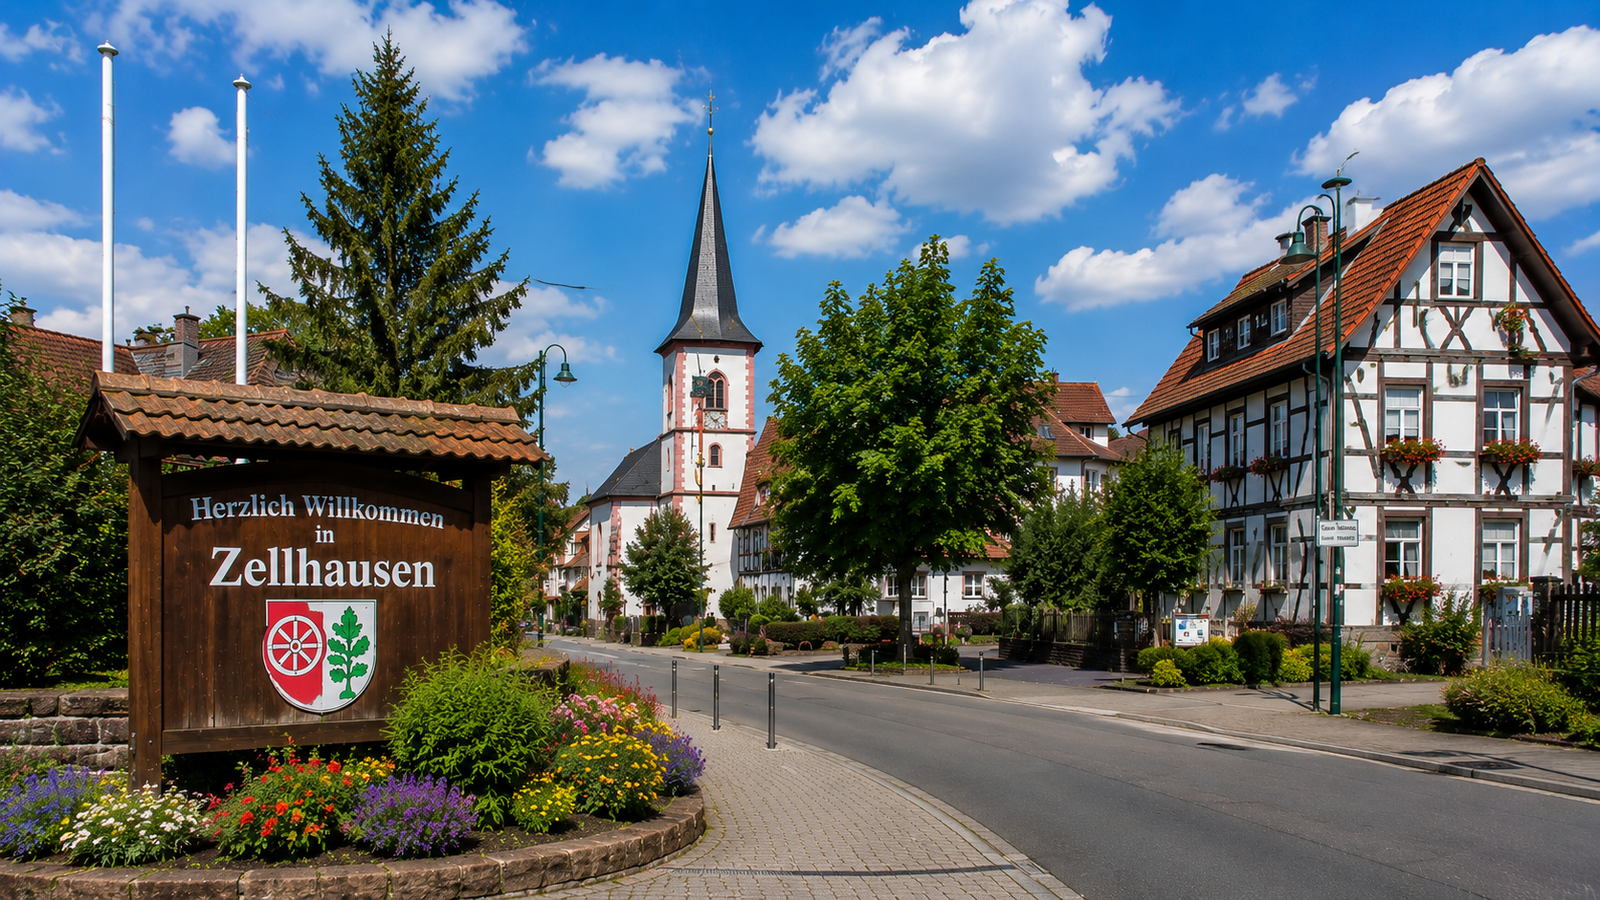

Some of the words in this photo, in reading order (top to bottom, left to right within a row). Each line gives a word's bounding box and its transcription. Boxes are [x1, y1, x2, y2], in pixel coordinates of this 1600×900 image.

[190, 494, 296, 521] Herzlich
[302, 495, 444, 529] Willkommen
[315, 525, 335, 543] in
[209, 547, 436, 588] Zellhausen
